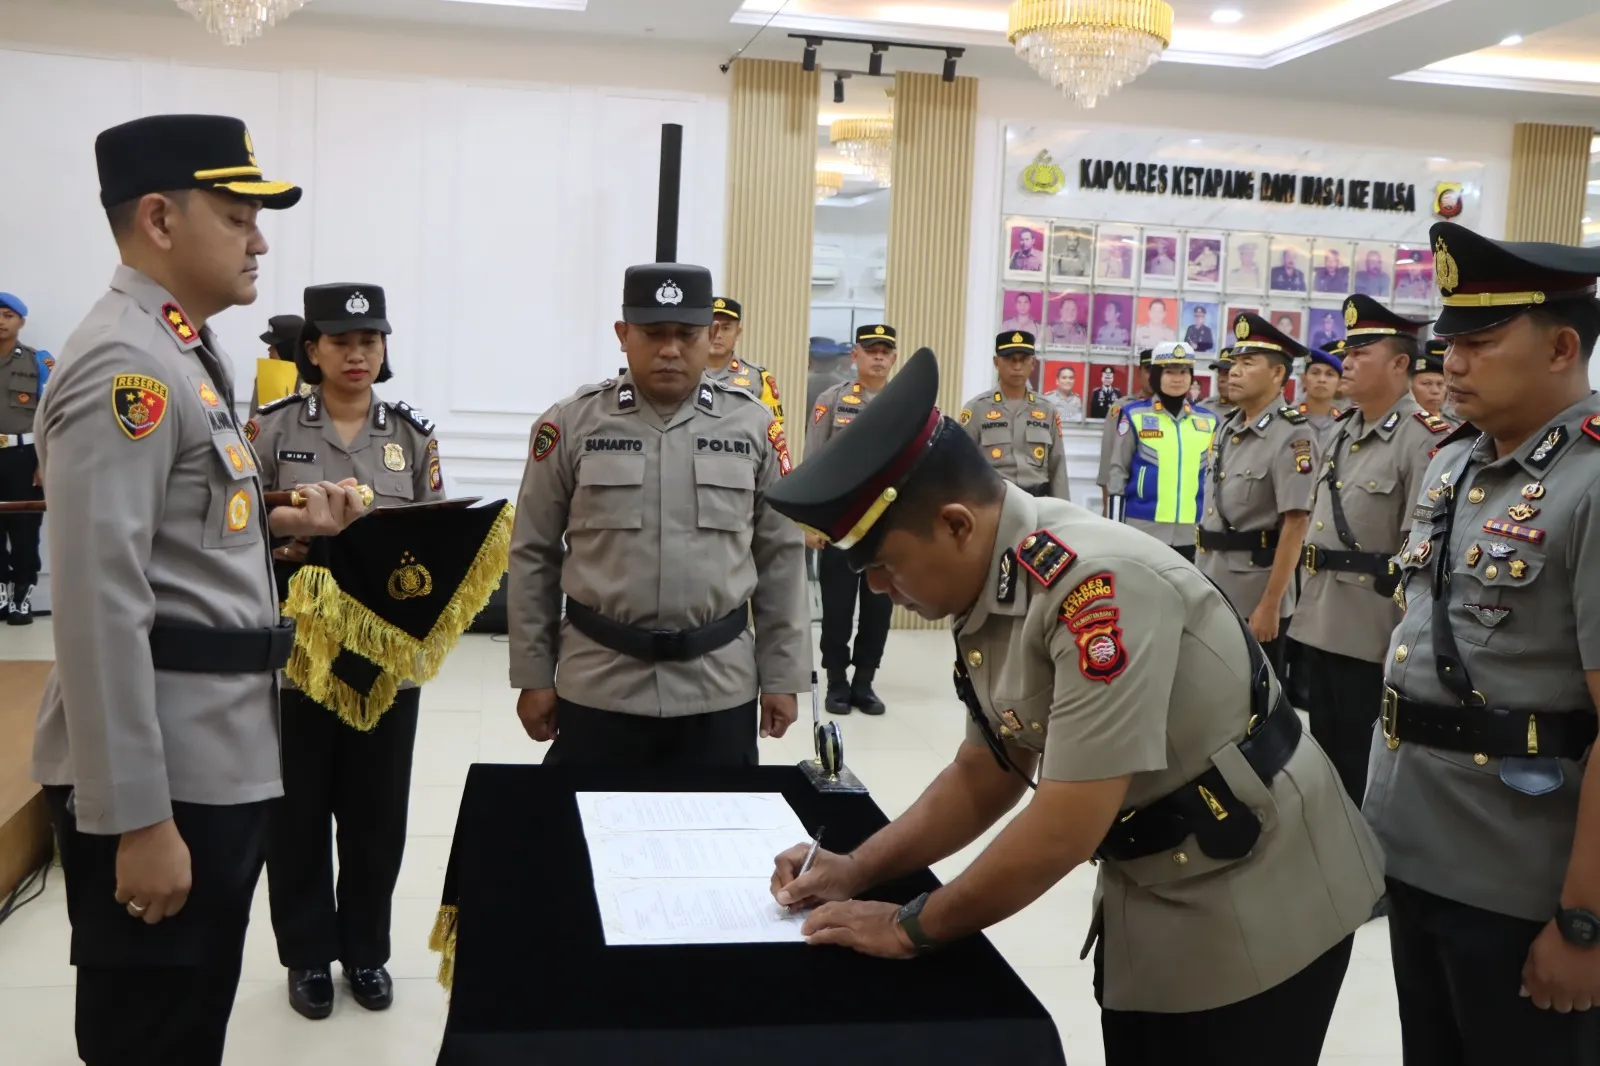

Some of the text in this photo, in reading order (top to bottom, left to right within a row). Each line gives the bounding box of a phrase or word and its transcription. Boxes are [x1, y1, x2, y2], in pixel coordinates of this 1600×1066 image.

[1080, 158, 1168, 193] KAPOLRES
[1171, 165, 1256, 200] KETAPANG
[1300, 175, 1345, 207] MASA
[1347, 179, 1370, 209] KE
[1372, 181, 1416, 212] MASA
[117, 376, 166, 397] RESERSE
[585, 438, 643, 452] SUHARTO
[697, 437, 751, 454] POLRI
[286, 452, 308, 460] MIMA
[1063, 579, 1103, 609] POLRES
[1064, 586, 1111, 618] KETAPANG
